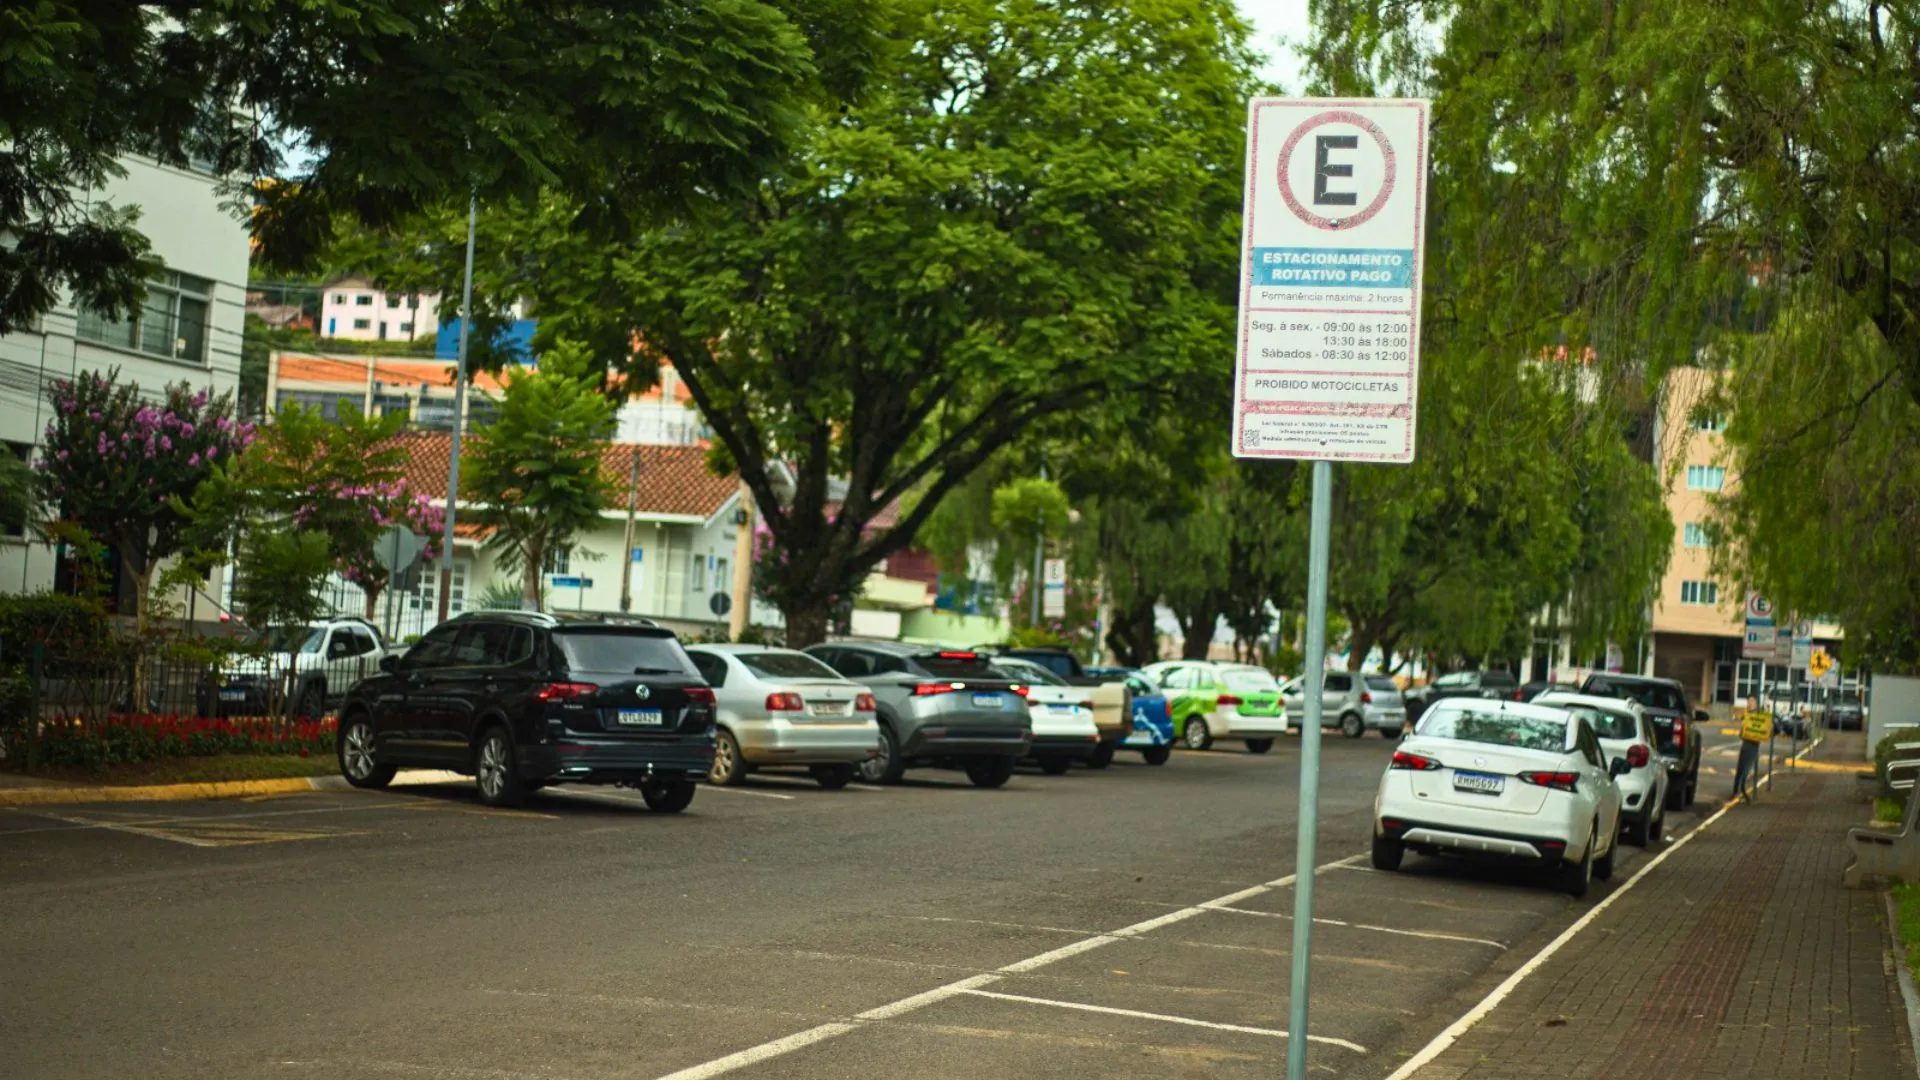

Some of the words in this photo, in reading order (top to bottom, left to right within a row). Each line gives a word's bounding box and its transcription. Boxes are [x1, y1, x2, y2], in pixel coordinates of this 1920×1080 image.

[1314, 135, 1358, 205] E
[1263, 253, 1402, 266] ESTACIONAMENTO
[1272, 269, 1346, 281] ROTATIVO
[1351, 270, 1392, 282] PAGO
[1368, 293, 1374, 302] 2
[1376, 294, 1404, 303] horas
[1251, 320, 1276, 333] Seg.
[1323, 322, 1355, 332] 09:00
[1376, 323, 1408, 333] 12:00
[1323, 336, 1355, 346] 13:30
[1376, 337, 1407, 347] 18:00
[1261, 348, 1312, 358] Sábados
[1322, 350, 1354, 360] 08:30
[1375, 351, 1407, 361] 12:00
[1255, 379, 1308, 389] PROIBIDO
[1311, 381, 1399, 392] MOTOCICLETAS
